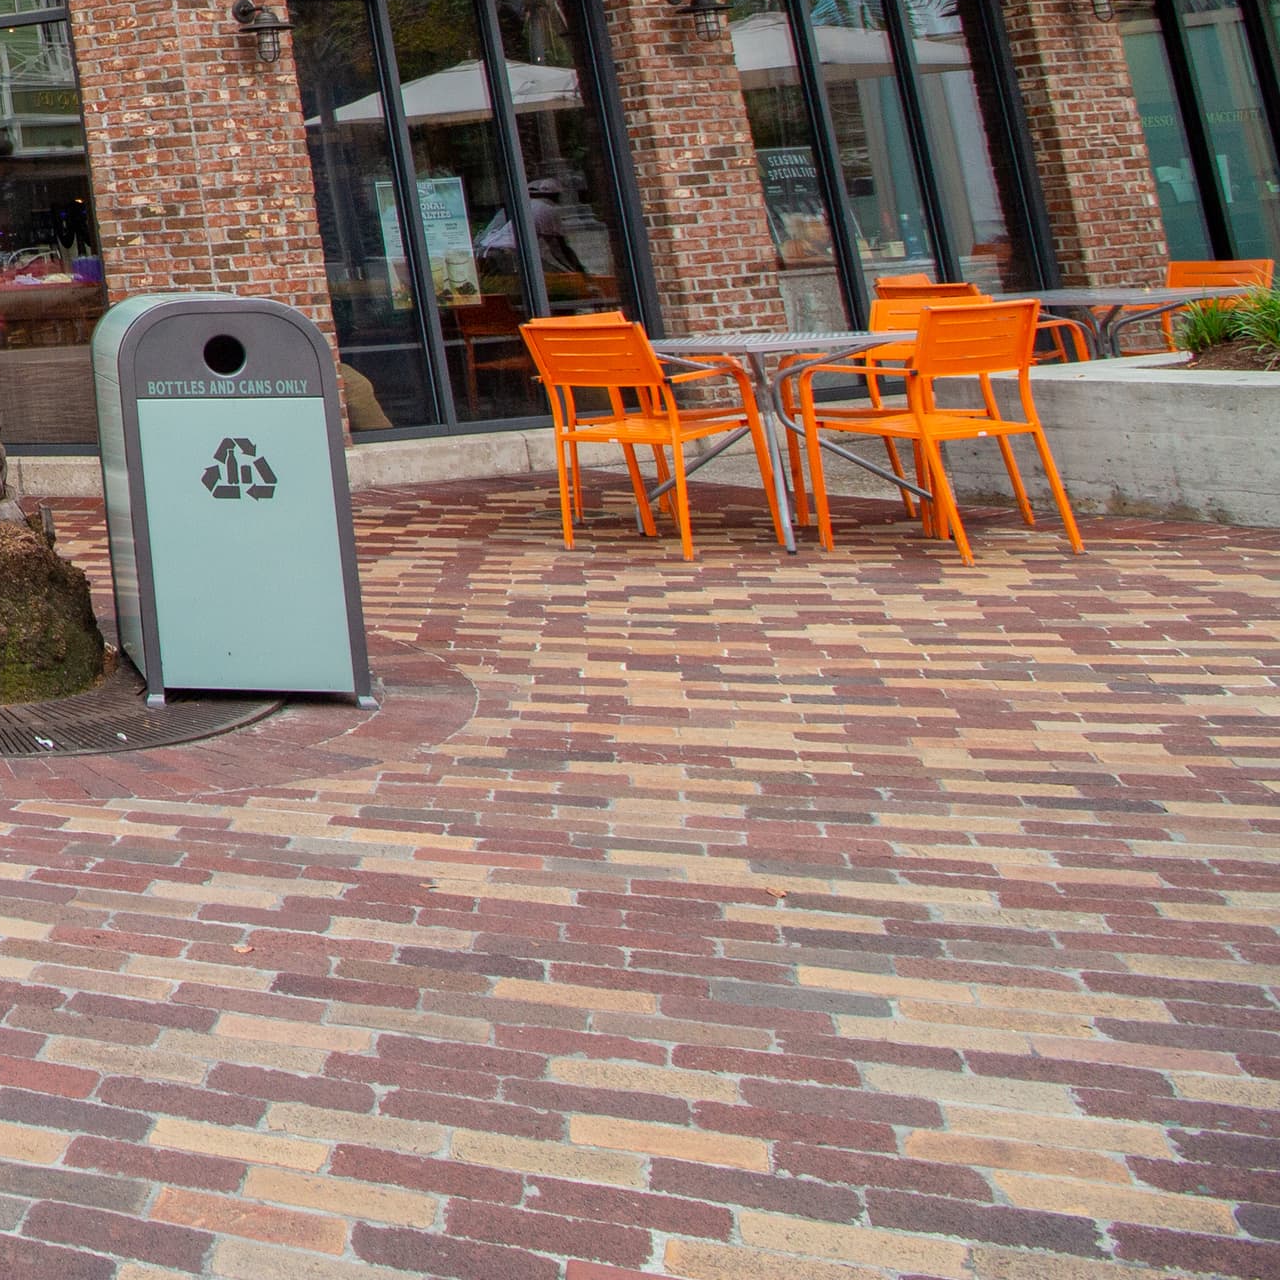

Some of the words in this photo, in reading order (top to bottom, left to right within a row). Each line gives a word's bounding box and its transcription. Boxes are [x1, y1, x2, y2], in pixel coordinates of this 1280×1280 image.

[147, 380, 206, 395] BOTTLES
[209, 380, 236, 395] AND
[239, 380, 272, 394] CANS
[275, 379, 308, 394] ONLY
